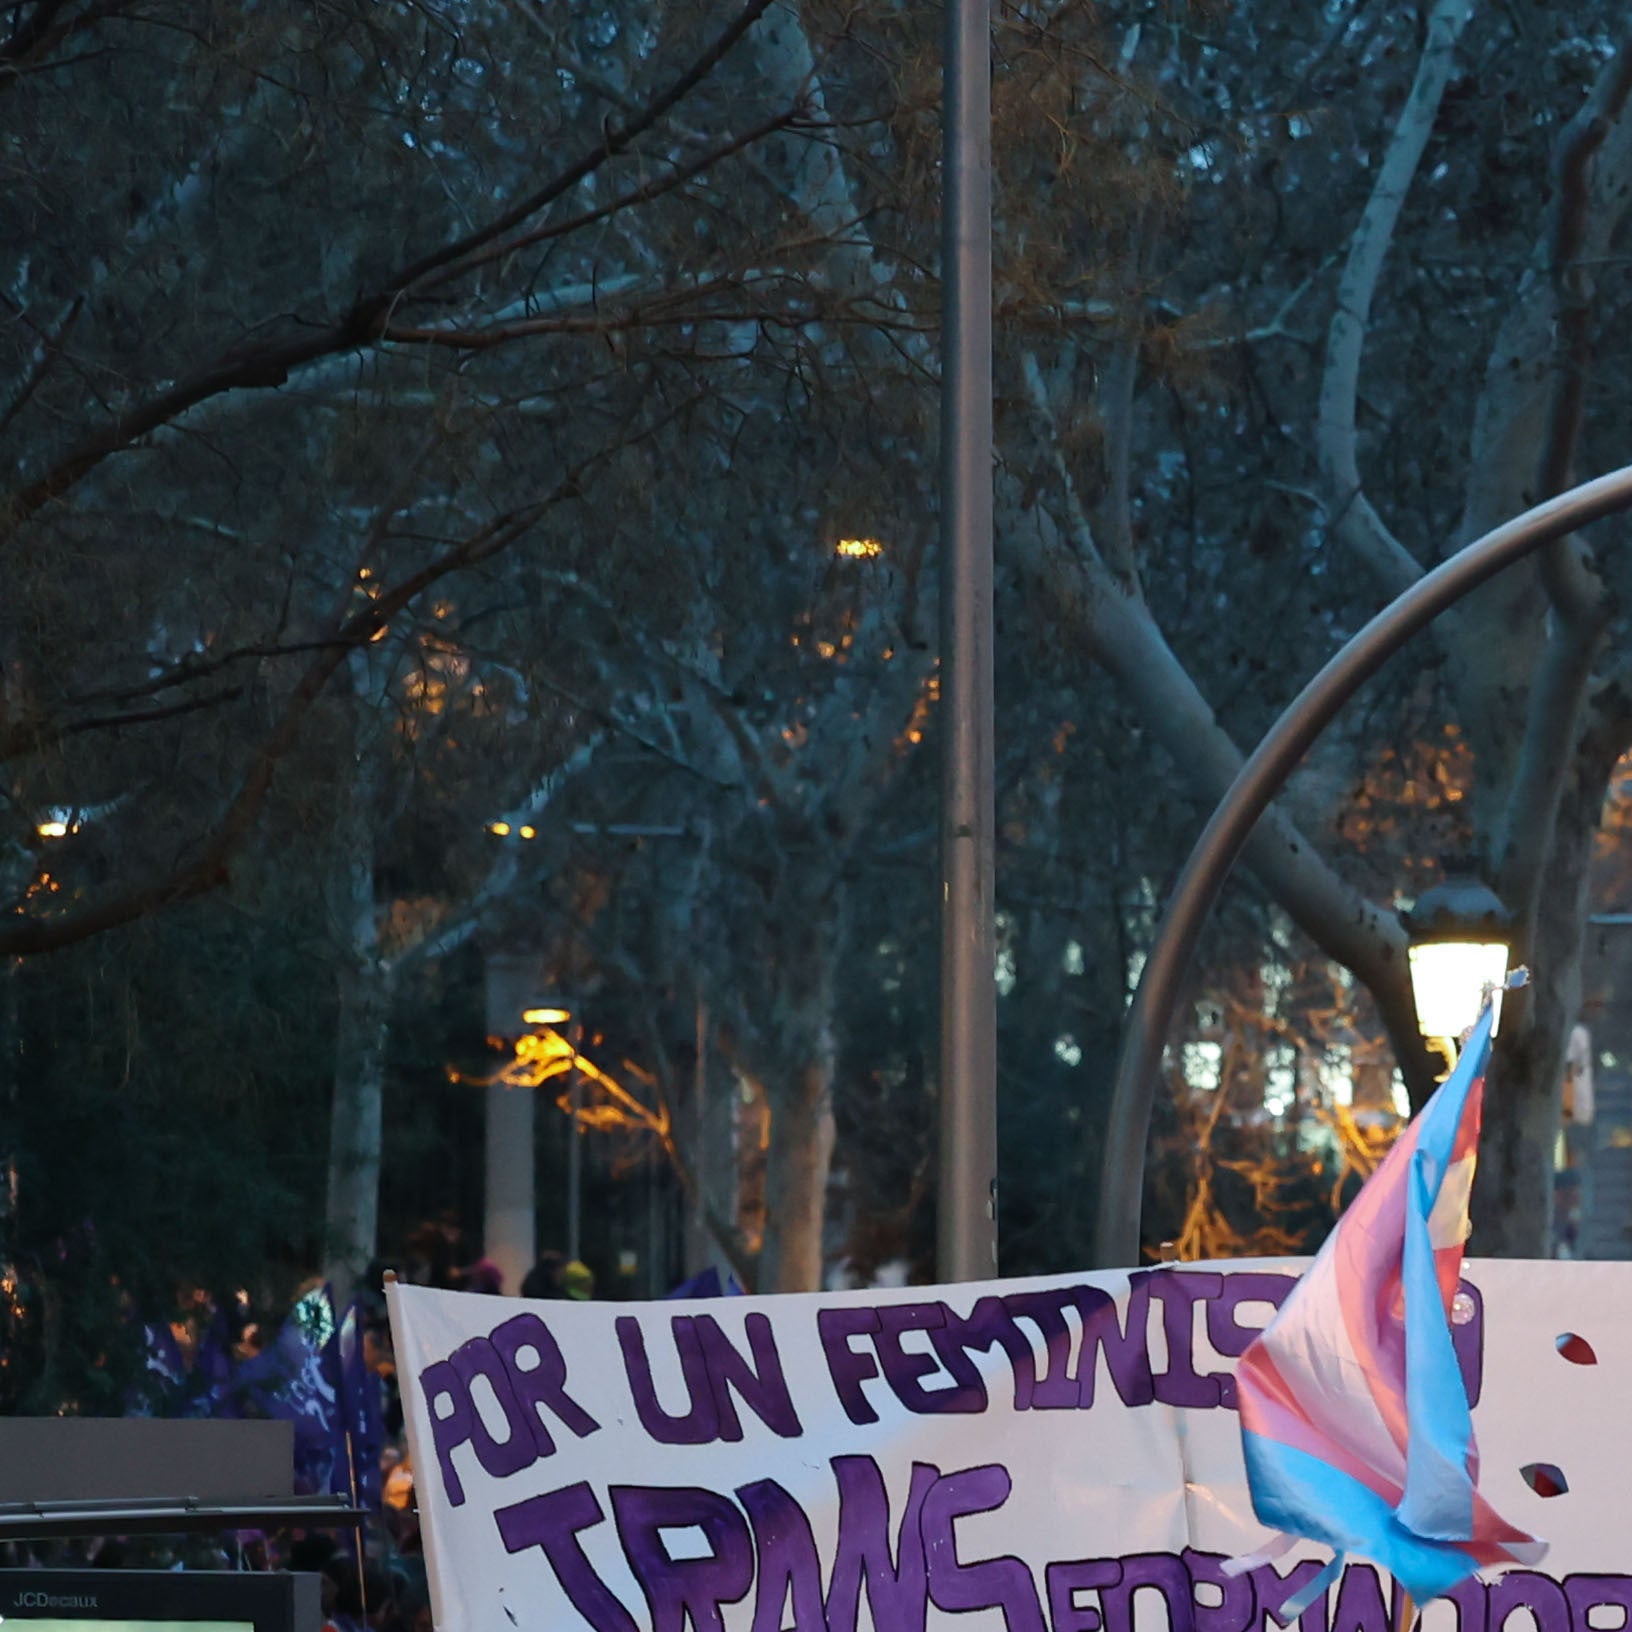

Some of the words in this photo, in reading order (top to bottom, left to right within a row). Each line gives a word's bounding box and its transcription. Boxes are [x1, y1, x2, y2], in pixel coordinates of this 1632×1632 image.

[420, 1313, 601, 1506] POR
[615, 1312, 803, 1443] UN
[817, 1270, 1484, 1424] FEMINIS
[14, 1592, 98, 1608] JCDecaux
